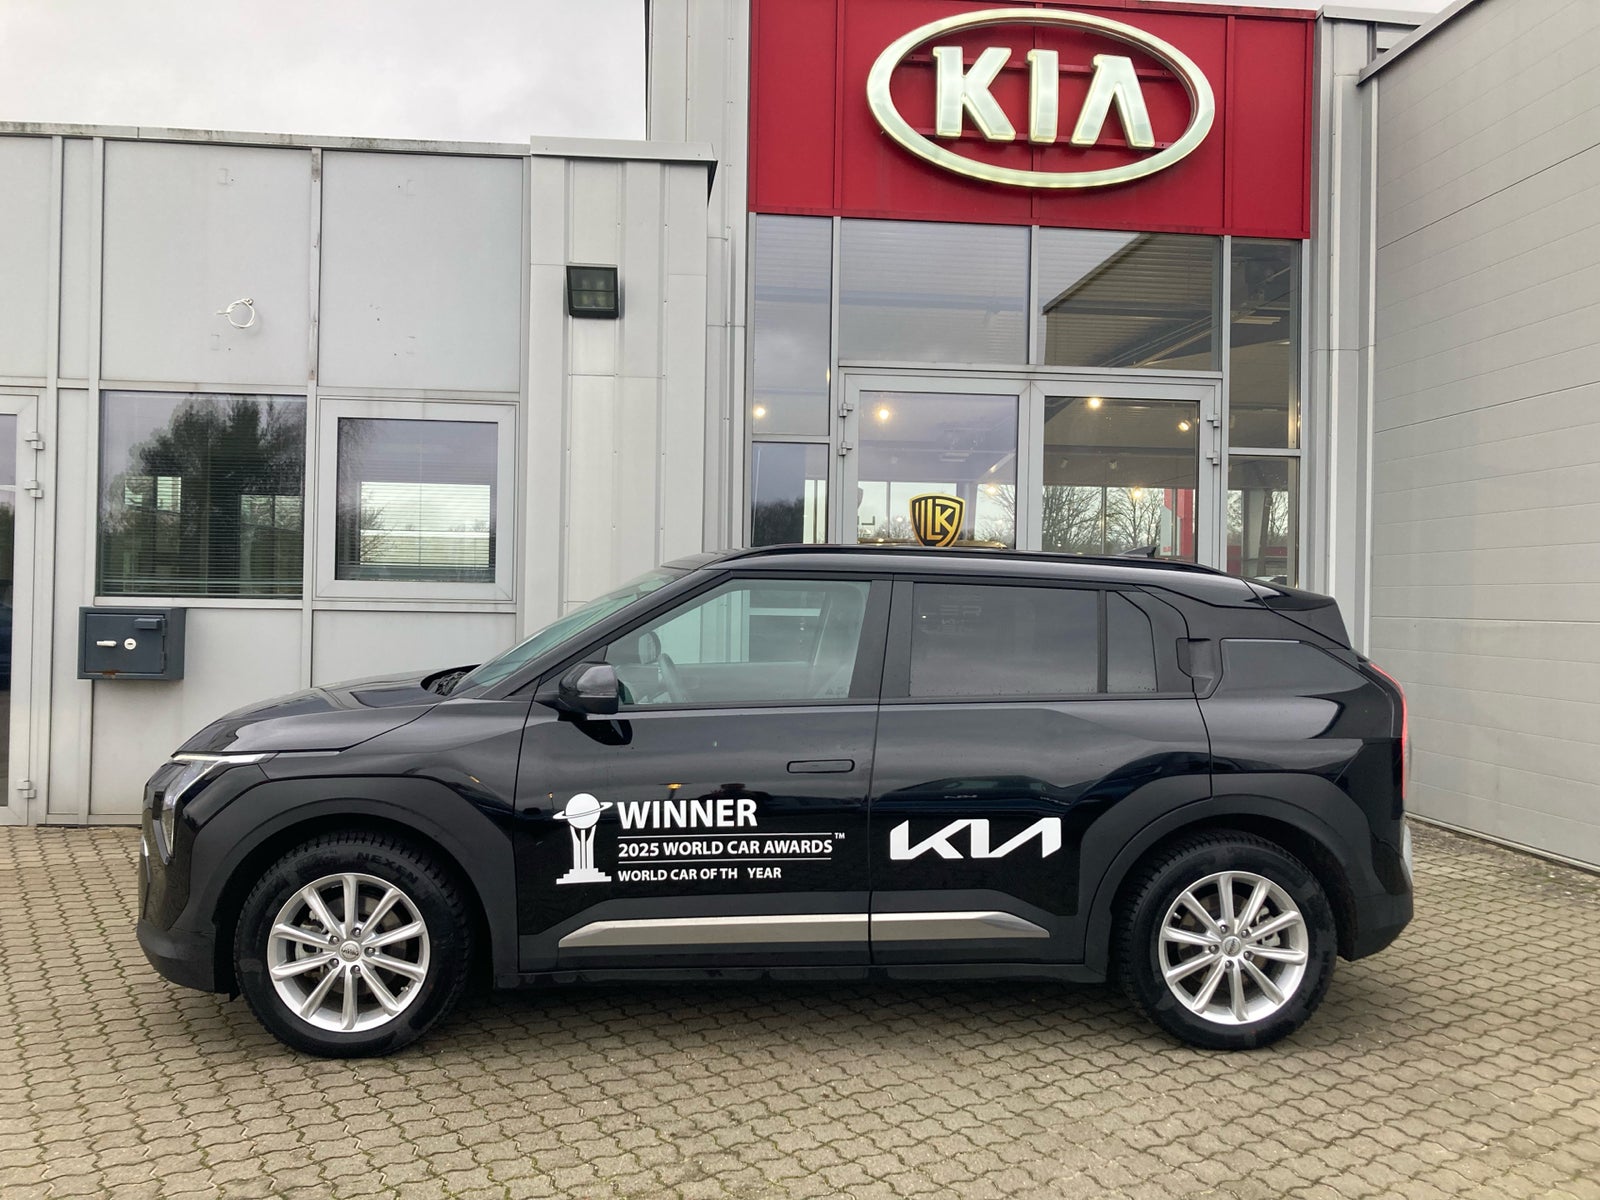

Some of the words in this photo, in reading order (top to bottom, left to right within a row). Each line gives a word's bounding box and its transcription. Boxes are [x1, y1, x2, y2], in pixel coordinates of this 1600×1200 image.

[932, 45, 1155, 148] KIA
[617, 799, 758, 829] WINNER
[618, 843, 660, 857] 2025
[663, 841, 724, 856] WORLD
[727, 840, 760, 854] CAR
[763, 839, 833, 854] AWARDS
[889, 817, 1062, 860] KIA
[618, 869, 668, 882] WORLD
[670, 868, 698, 881] CAR
[700, 868, 718, 880] OF
[747, 867, 782, 879] YEAR
